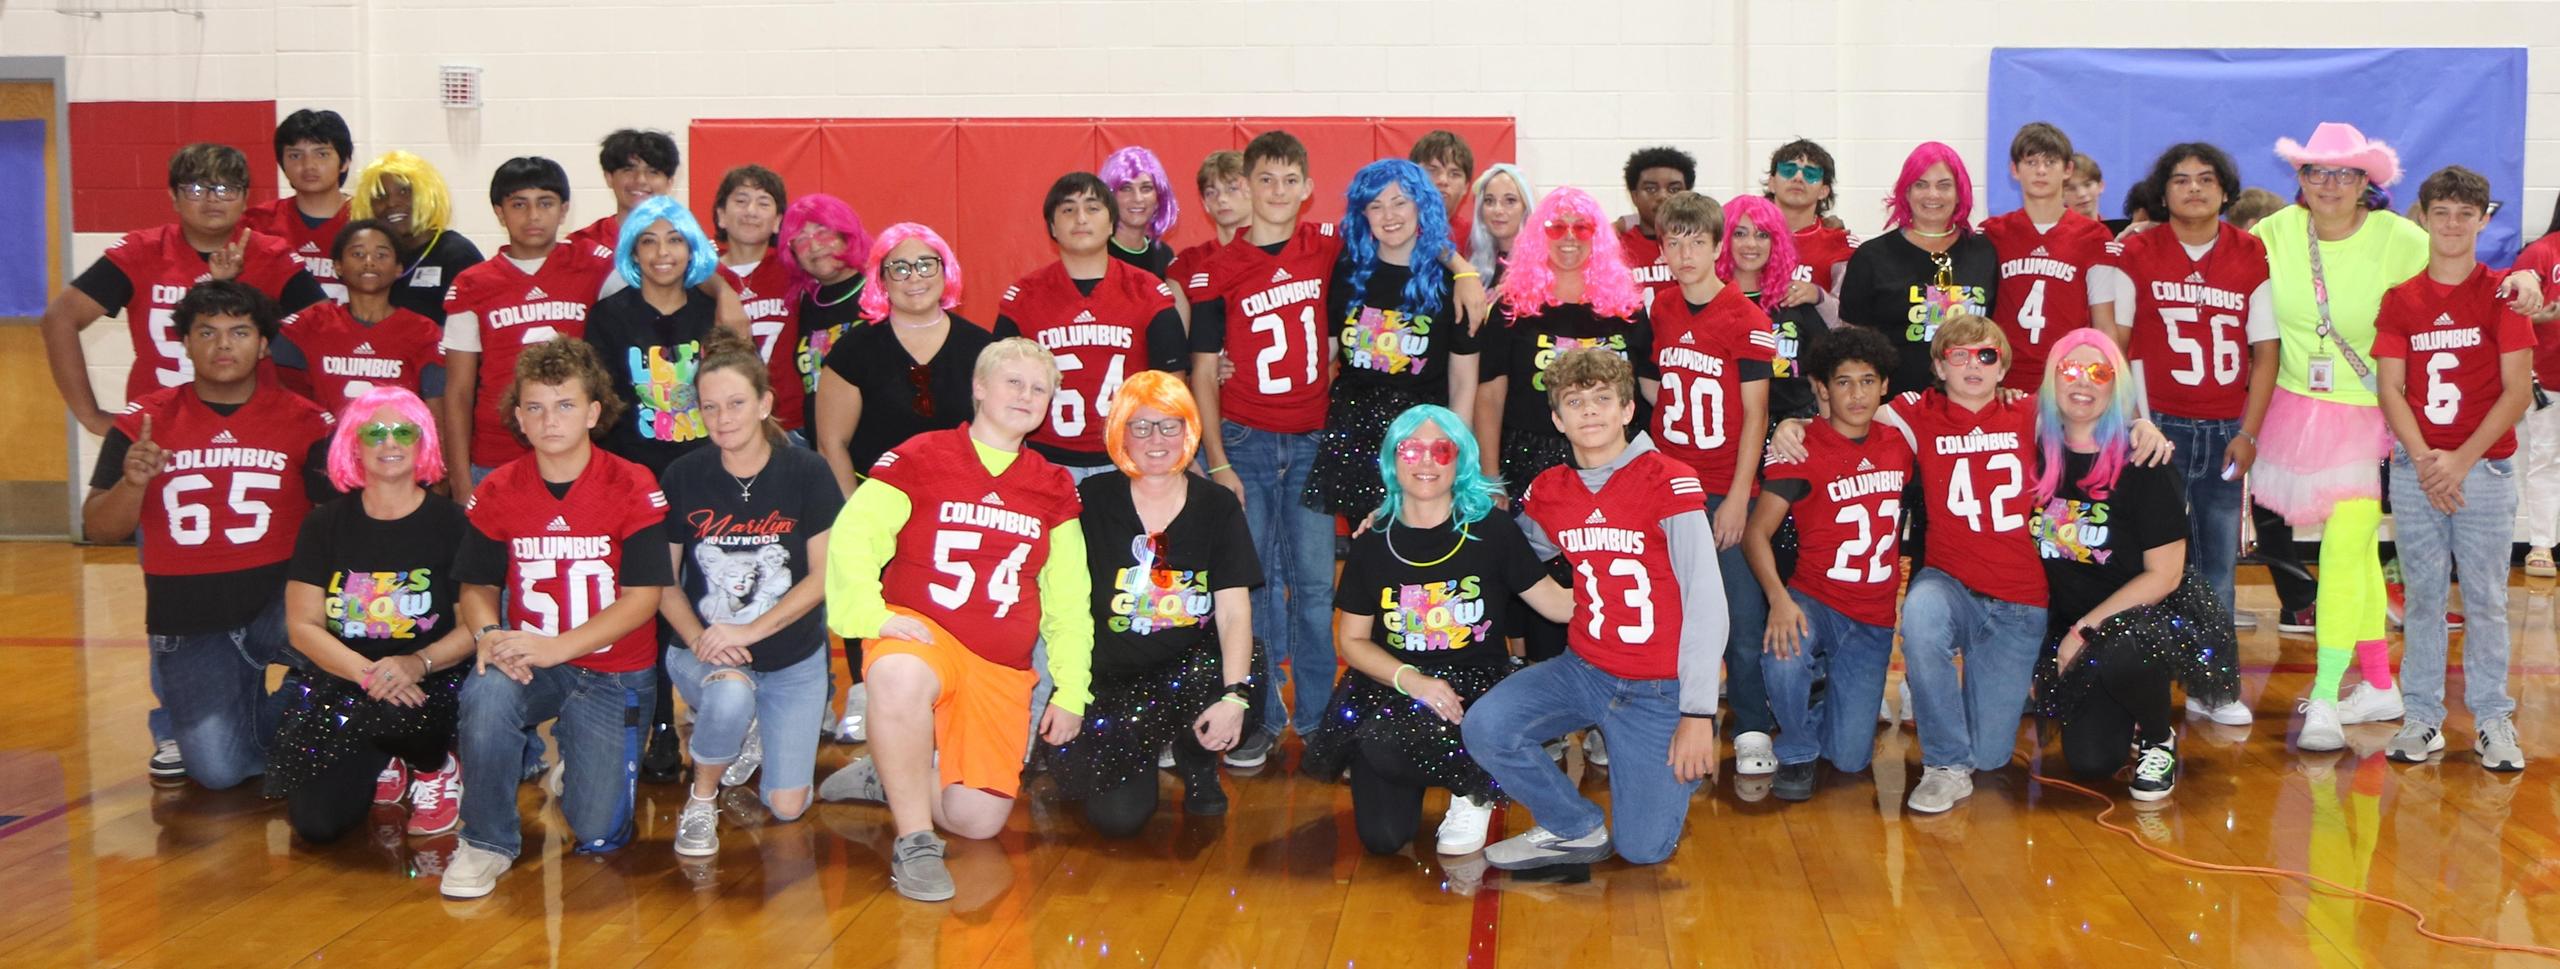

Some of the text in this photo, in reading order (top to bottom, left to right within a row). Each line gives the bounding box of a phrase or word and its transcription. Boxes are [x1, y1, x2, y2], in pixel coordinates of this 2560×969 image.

[2001, 258, 2077, 282] COLUMBUS
[1241, 278, 1322, 317] COLUMBUS
[2017, 279, 2046, 344] 4
[2151, 280, 2245, 312] COLUMBUS
[488, 301, 587, 329] COLUMBUS
[1345, 304, 1433, 335] LET'S
[1038, 324, 1133, 350] COLUMBUS
[1250, 305, 1318, 394] 21
[1341, 326, 1430, 356] GLOW
[2158, 307, 2240, 385] 56
[2410, 327, 2481, 351] COLUMBUS
[323, 355, 403, 379] COLUMBUS
[1051, 353, 1126, 437] 64
[2424, 352, 2461, 425] 6
[1662, 372, 1727, 450] 20
[1936, 431, 2019, 455] COLUMBUS
[1827, 470, 1905, 503] COLUMBUS
[1946, 453, 2025, 532] 42
[162, 474, 282, 546] 65
[687, 508, 798, 538] Marilyn
[940, 501, 1042, 540] COLUMBUS
[512, 535, 612, 560] COLUMBUS
[703, 533, 780, 546] HOLLYWOOD
[1558, 527, 1646, 555] COLUMBUS
[1826, 499, 1900, 583] 22
[2028, 516, 2109, 547] GLOW
[327, 567, 432, 594] LET'S
[928, 529, 1033, 618] 54
[325, 591, 433, 622] GLOW
[517, 559, 616, 654] 50
[1111, 591, 1212, 617] GLOW
[1381, 575, 1481, 610] LET'S
[1576, 558, 1655, 644] 13
[1383, 598, 1485, 632] GLOW
[1387, 620, 1493, 652] CRAZY
